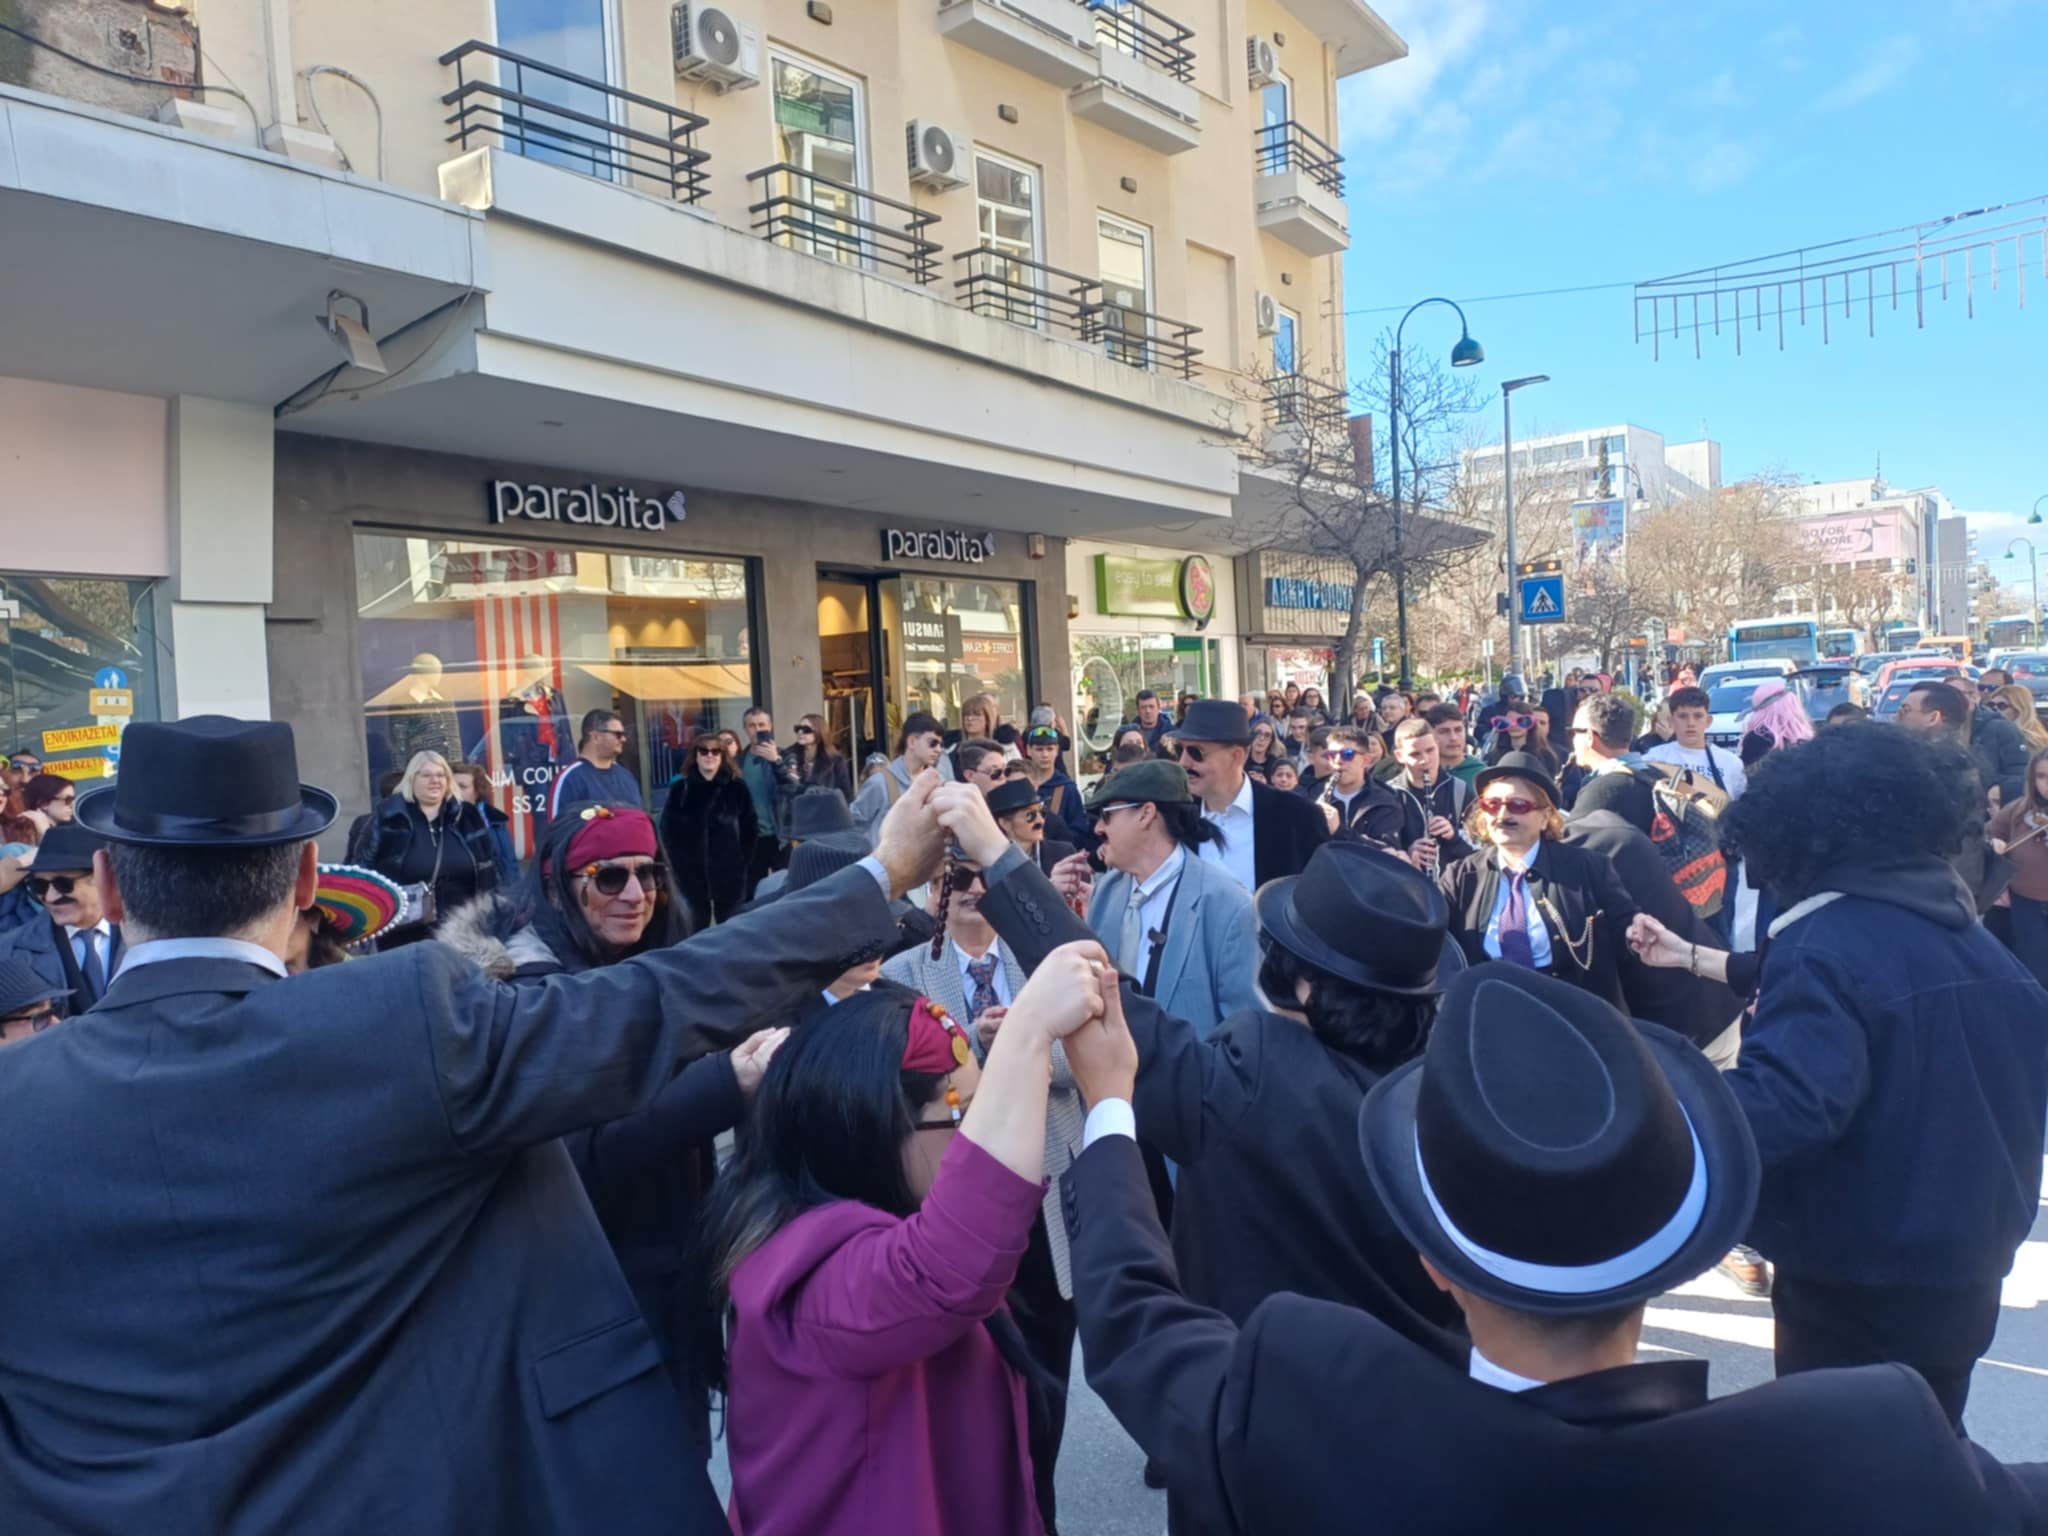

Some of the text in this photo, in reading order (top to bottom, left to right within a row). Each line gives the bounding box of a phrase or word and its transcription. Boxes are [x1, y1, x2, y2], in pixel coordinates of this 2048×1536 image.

[494, 479, 665, 531] parabita
[888, 529, 983, 563] parabita
[512, 793, 546, 814] SS 2
